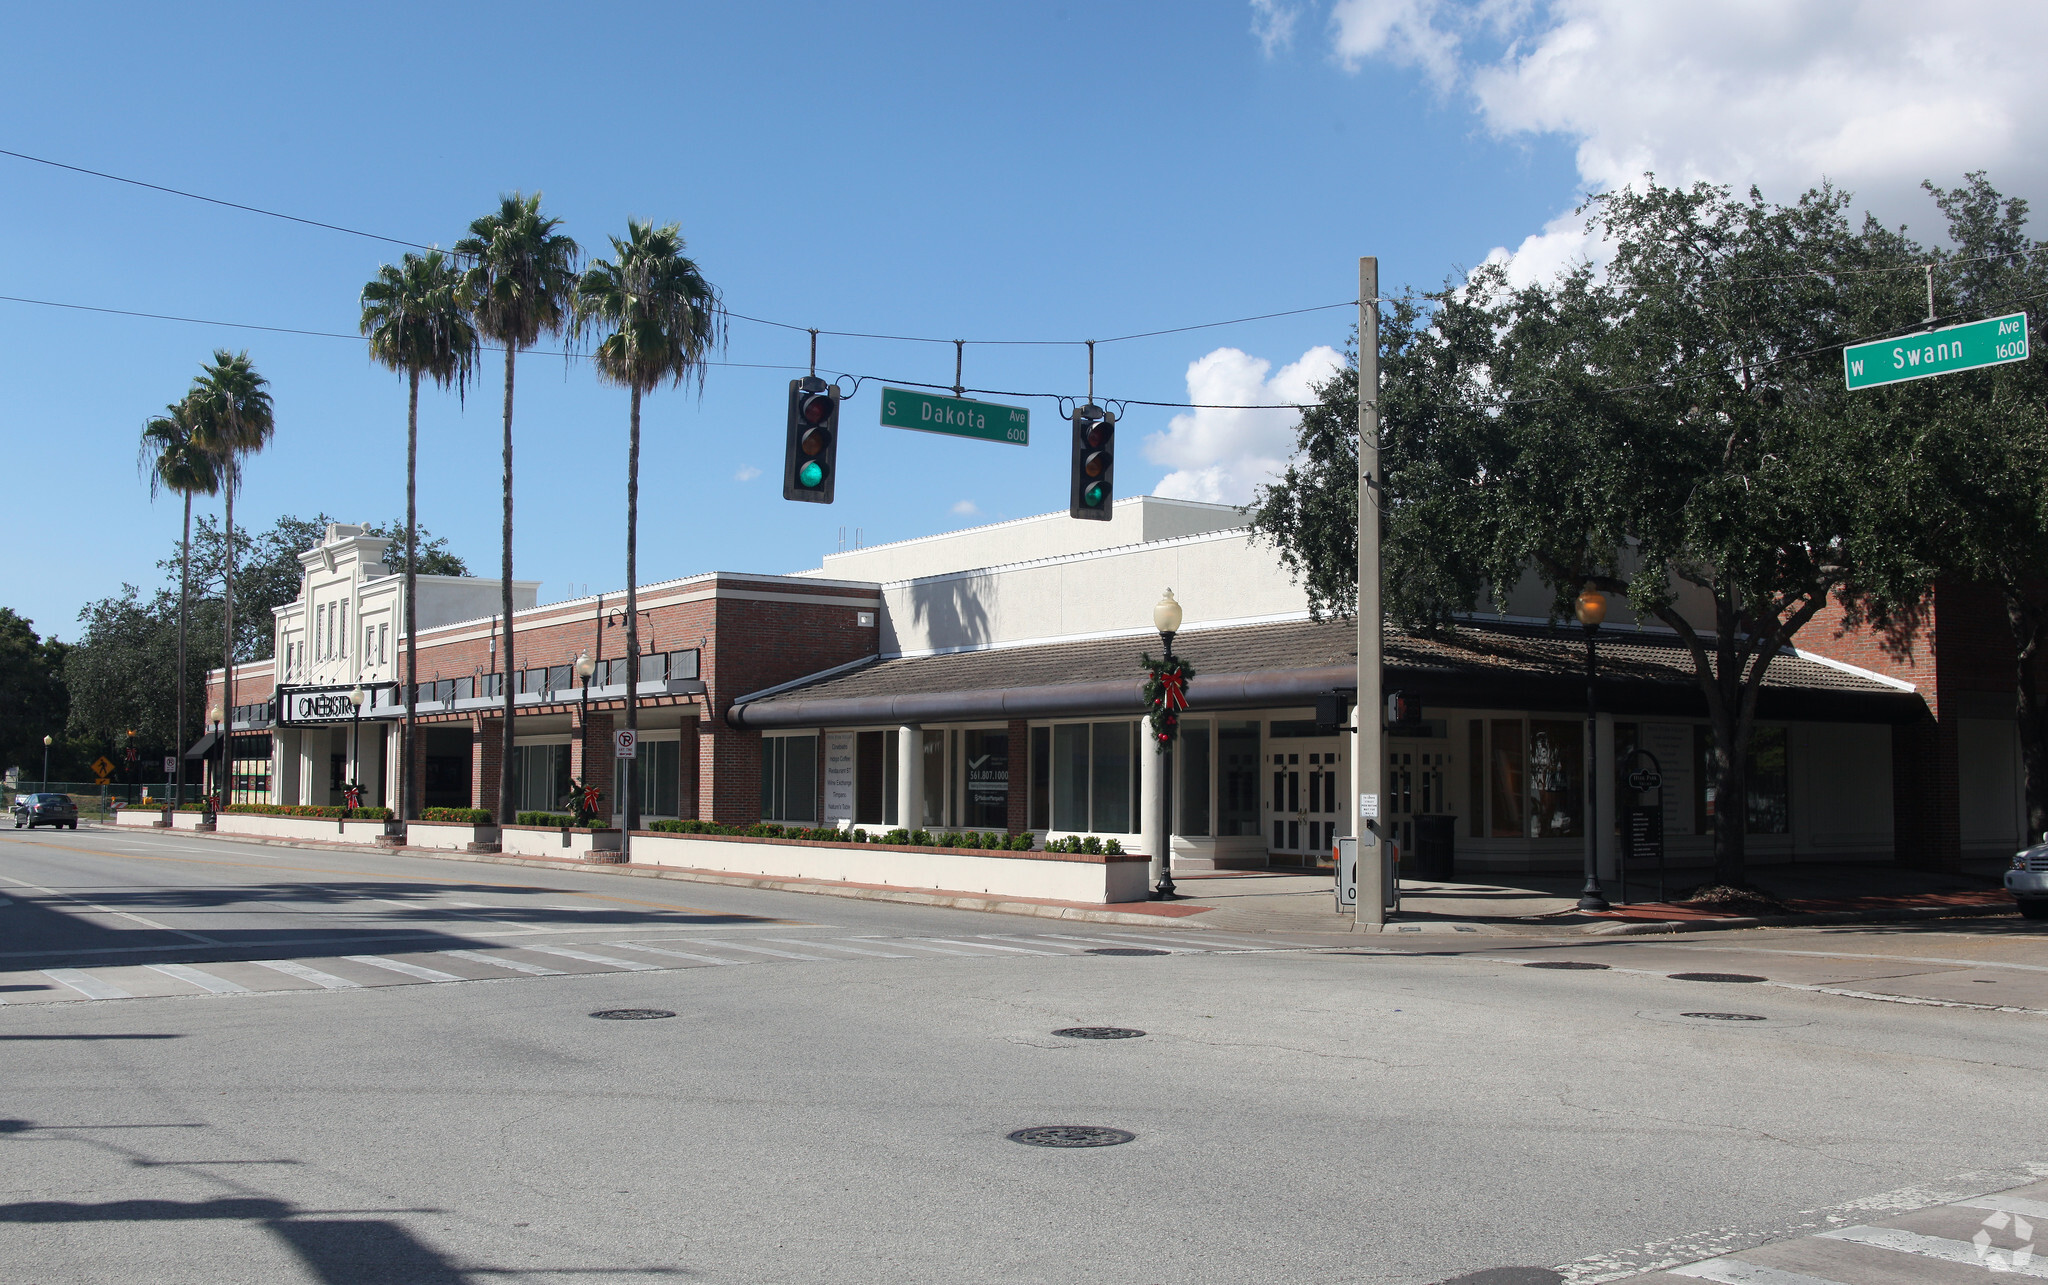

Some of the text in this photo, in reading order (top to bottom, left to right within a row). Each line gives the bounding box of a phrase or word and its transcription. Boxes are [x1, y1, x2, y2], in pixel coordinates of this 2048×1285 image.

[1998, 321, 2020, 336] Ave
[1996, 340, 2024, 359] 1600
[1851, 340, 1963, 377] W Swann
[887, 401, 985, 429] S Dakota
[1009, 410, 1026, 423] Ave
[1007, 428, 1026, 442] 600
[970, 770, 1009, 780] 561.807.1000
